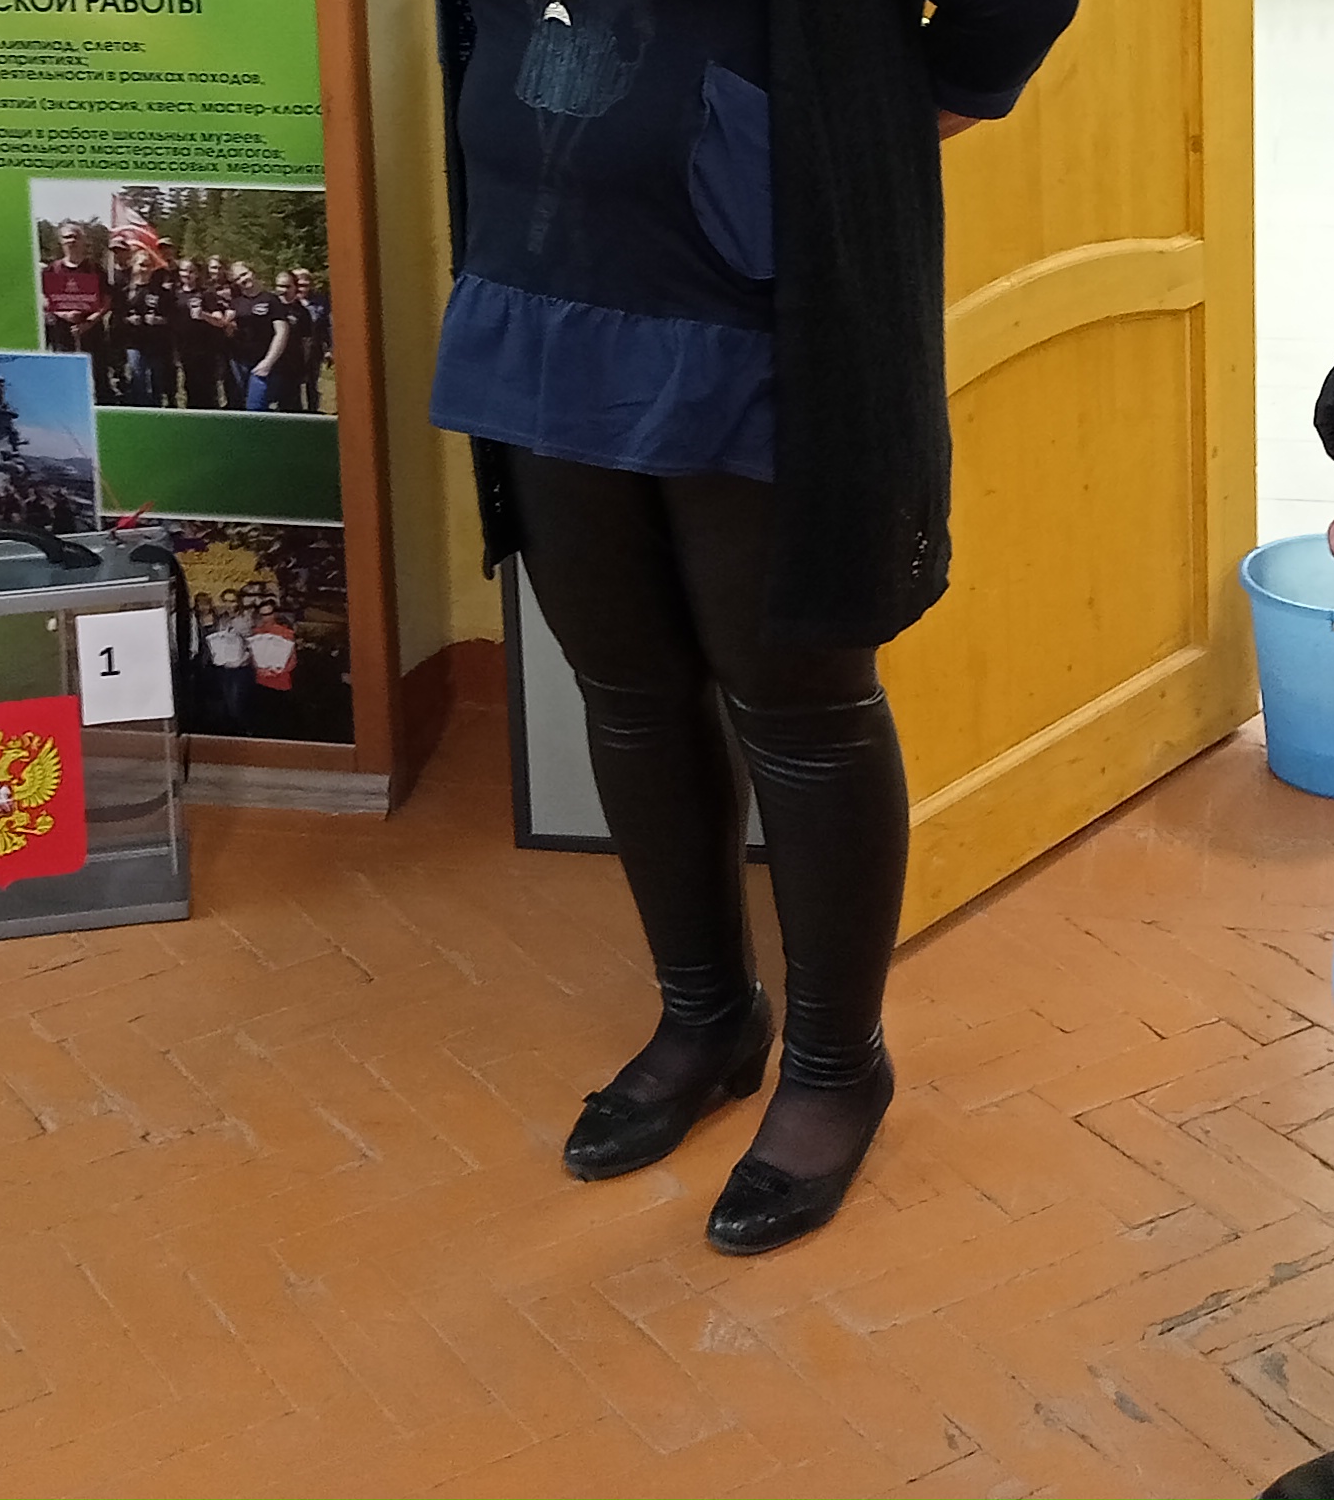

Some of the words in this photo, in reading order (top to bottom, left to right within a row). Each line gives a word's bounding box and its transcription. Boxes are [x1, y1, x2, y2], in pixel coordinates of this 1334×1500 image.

[119, 71, 185, 84] рамках
[48, 126, 109, 141] работе
[99, 647, 121, 677] 1
